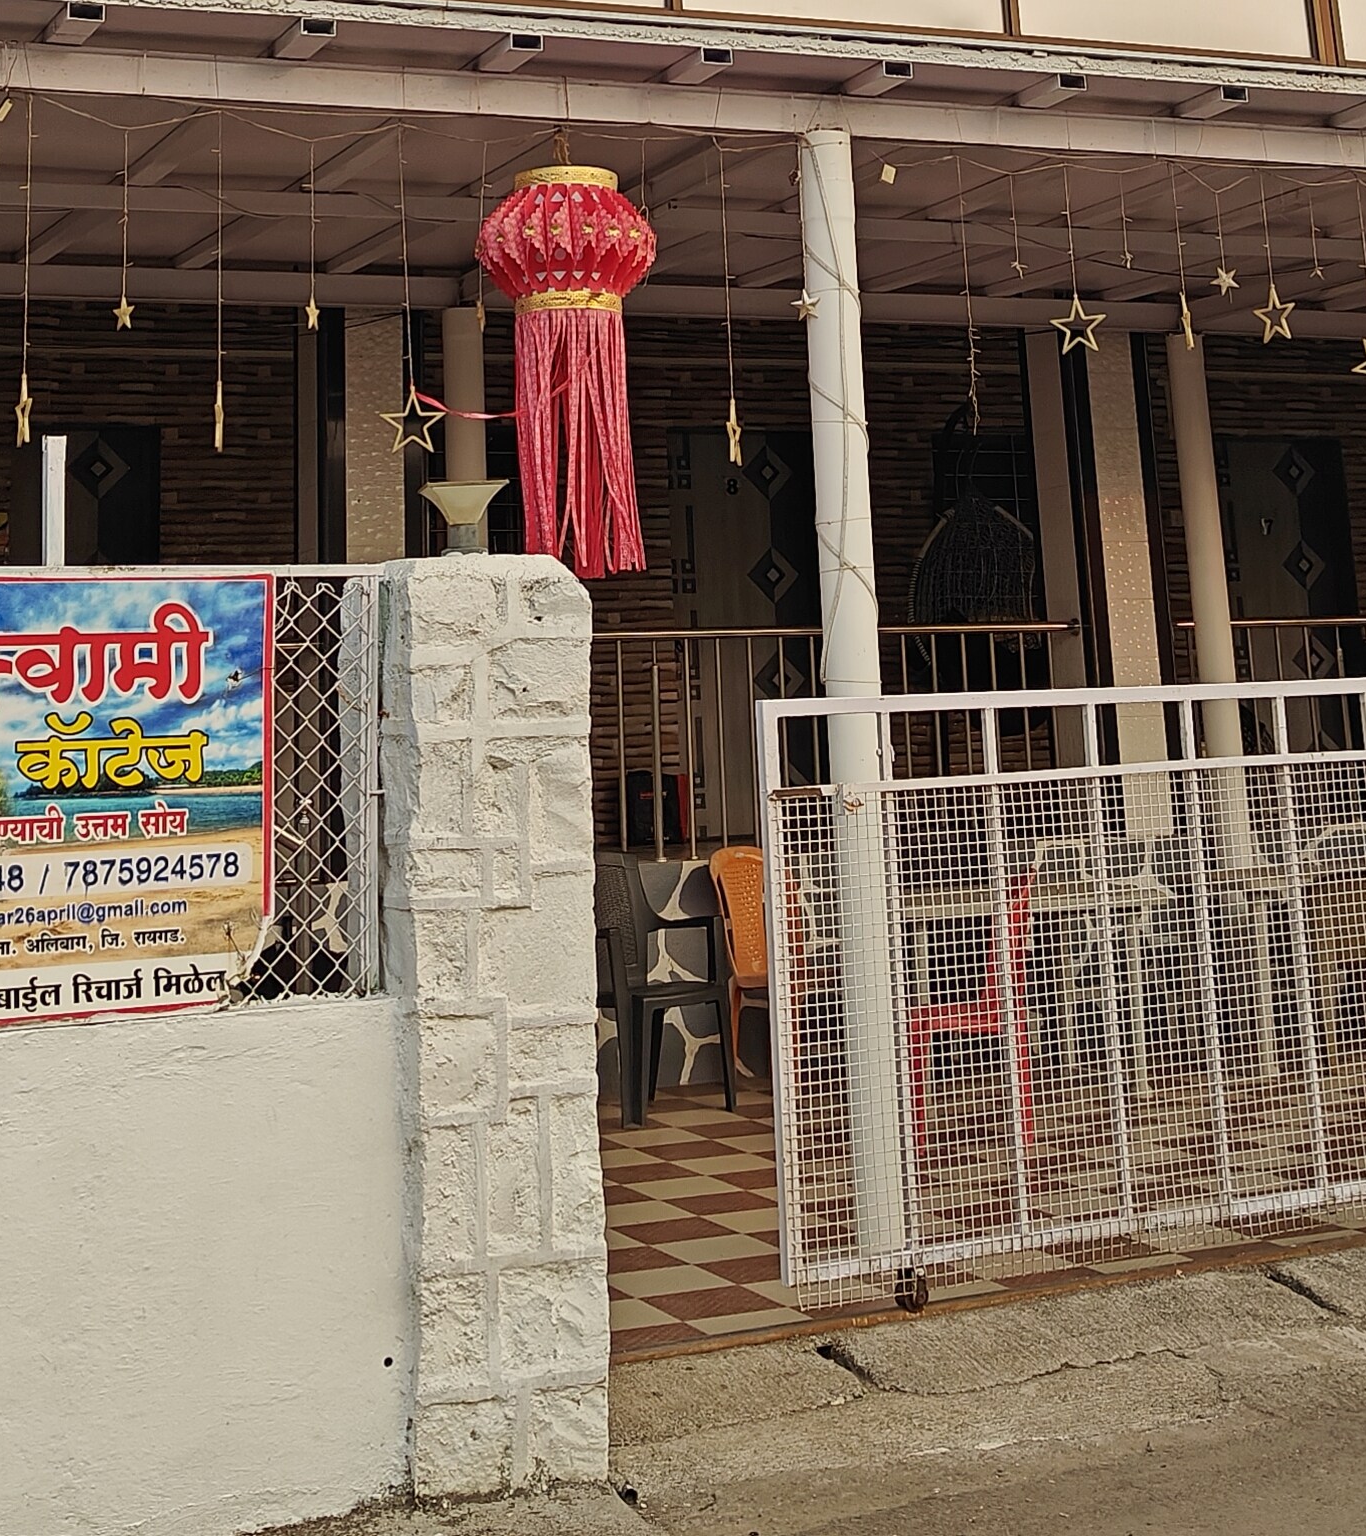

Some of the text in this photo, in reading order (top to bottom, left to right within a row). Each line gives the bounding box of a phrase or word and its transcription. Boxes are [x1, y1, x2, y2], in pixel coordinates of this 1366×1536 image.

[726, 478, 739, 495] 8
[15, 712, 208, 790] कॉटेज
[75, 813, 129, 838] उत्तम
[140, 801, 187, 835] सोय
[39, 864, 50, 895] /
[64, 852, 239, 893] 7875924578
[100, 928, 126, 948] जि.
[134, 928, 185, 946] रायगड.
[72, 968, 143, 1004] रिचार्ज
